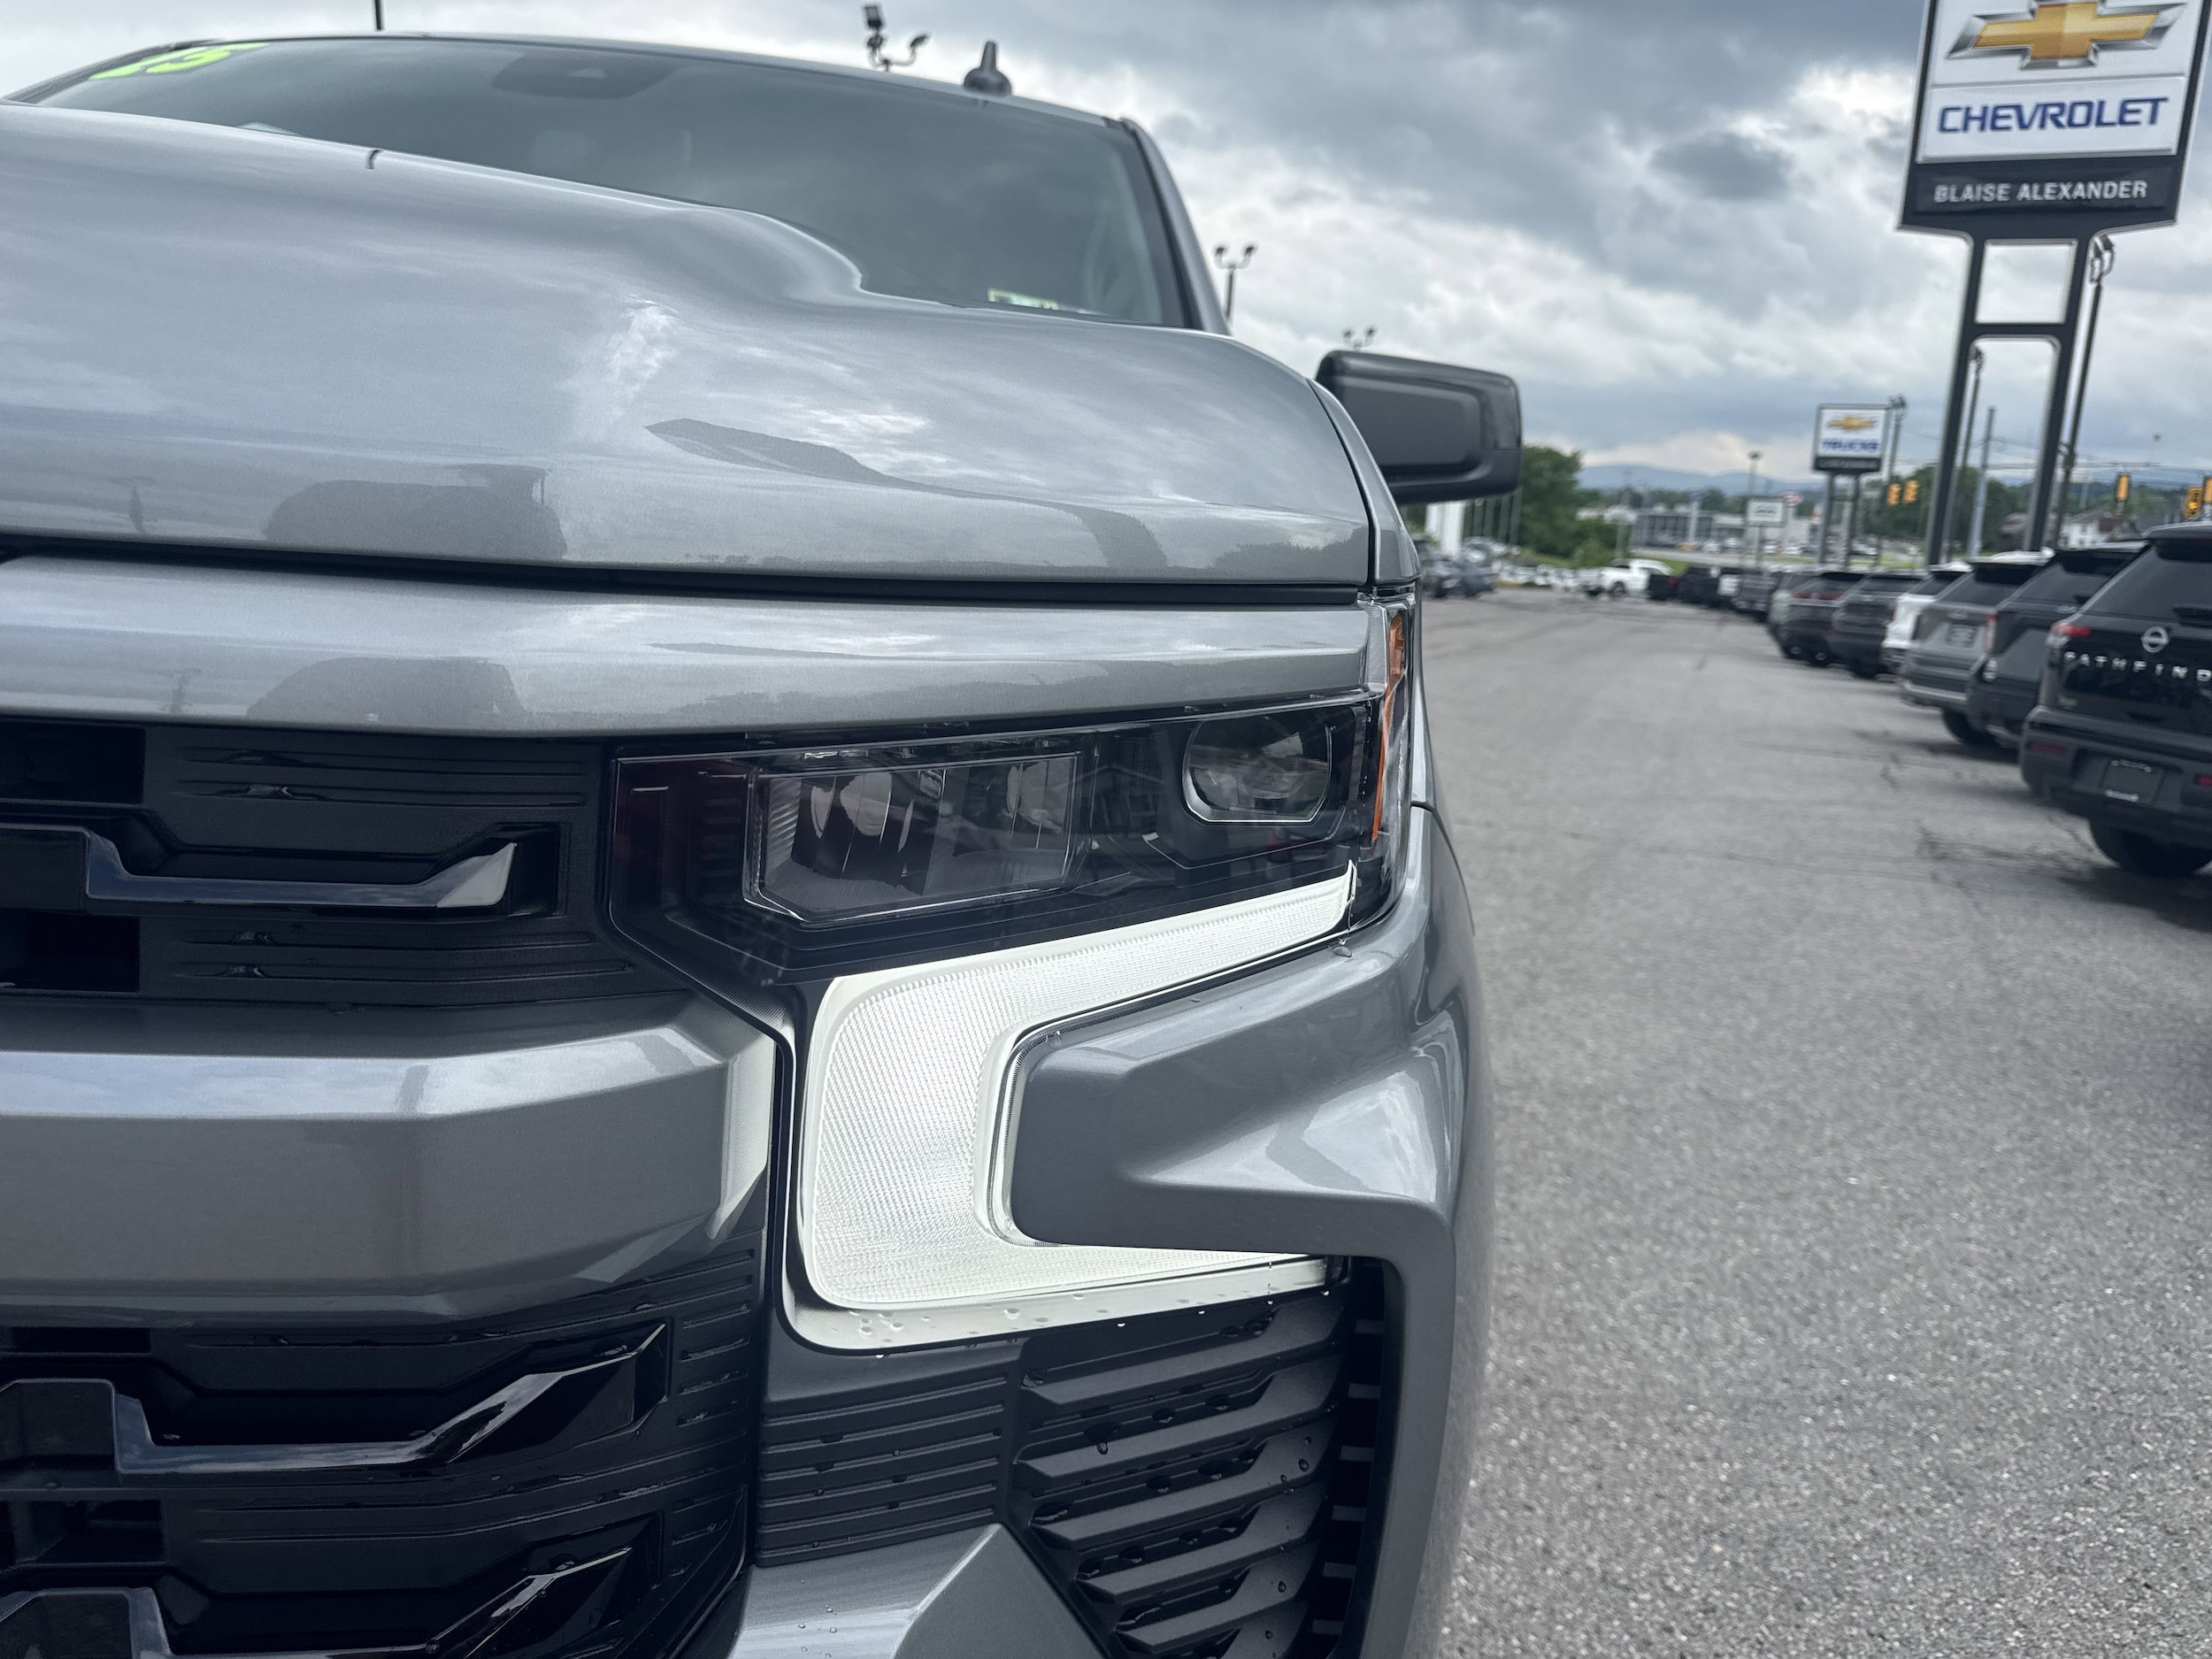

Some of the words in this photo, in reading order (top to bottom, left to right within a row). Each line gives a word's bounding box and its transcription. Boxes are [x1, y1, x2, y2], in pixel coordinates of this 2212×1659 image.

[1939, 97, 2169, 134] CHEVROLET
[1934, 183, 2011, 203] BLAISE
[2016, 180, 2147, 201] ALEXANDER
